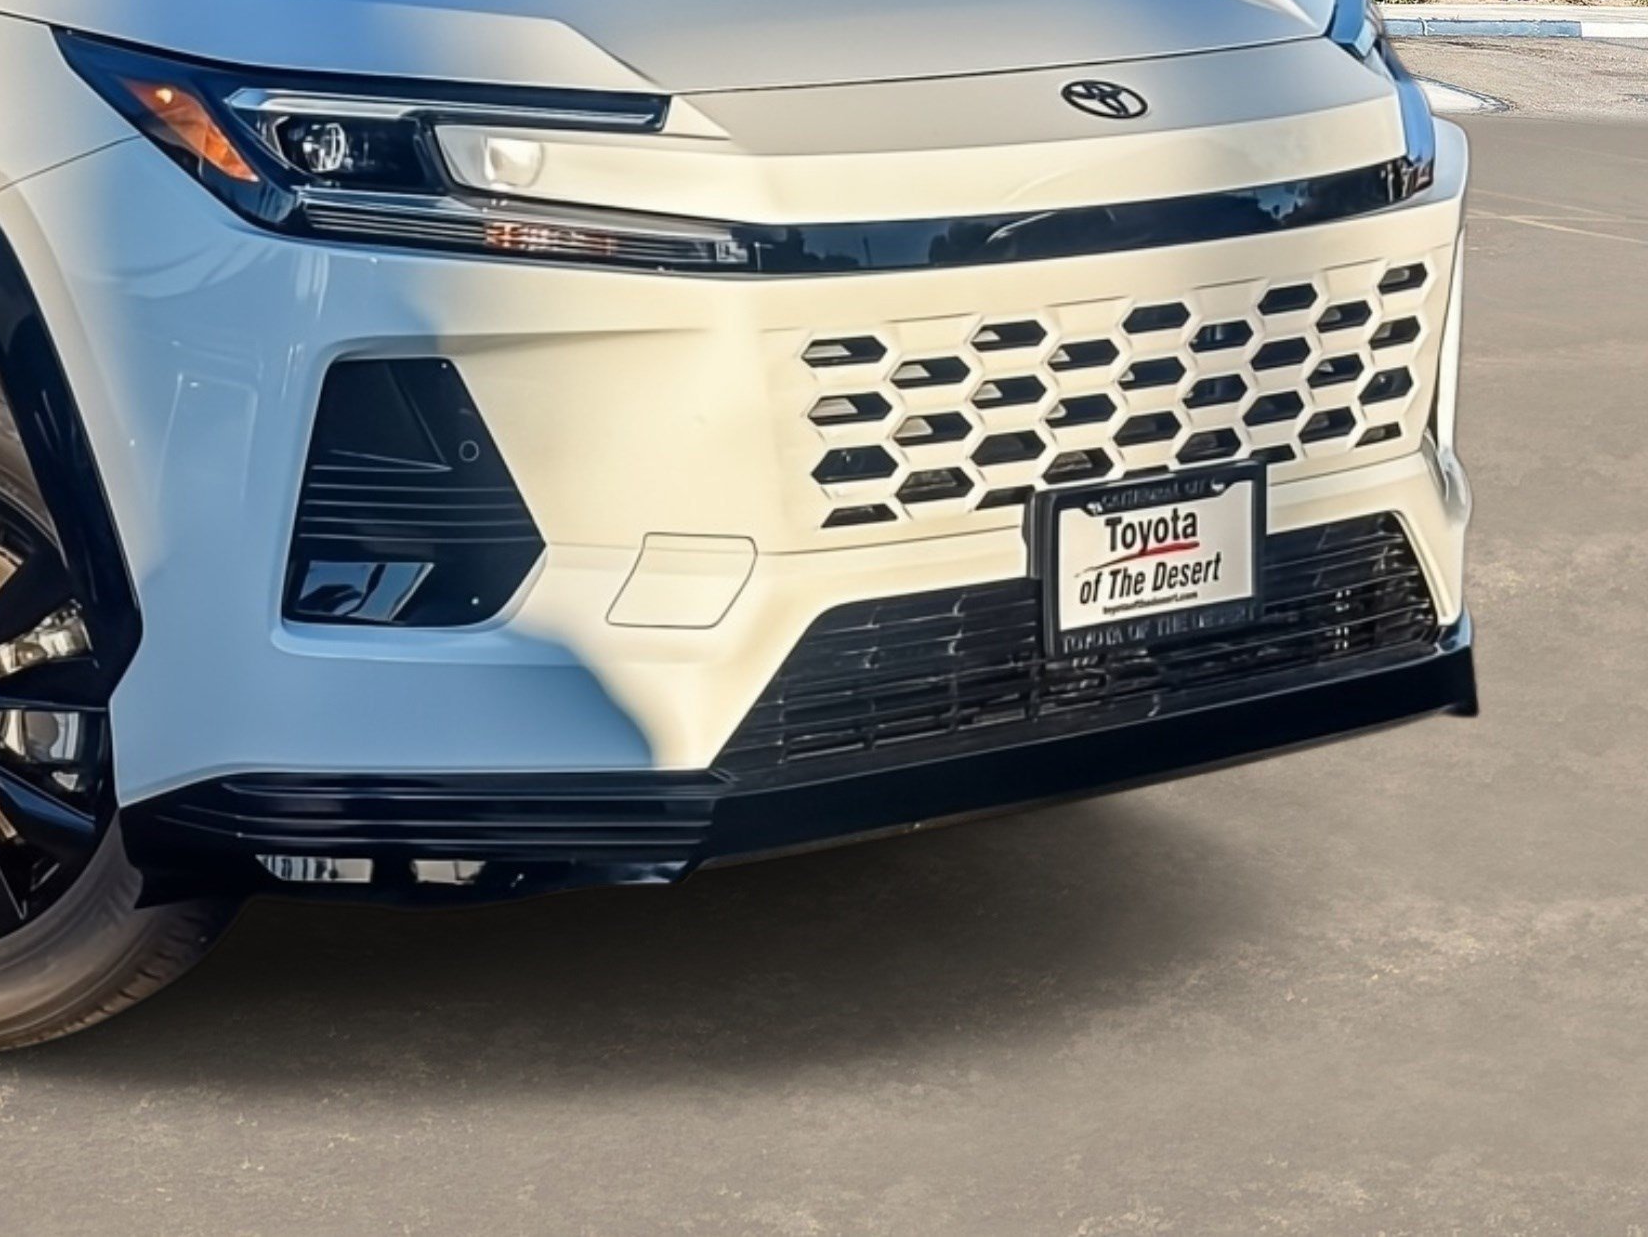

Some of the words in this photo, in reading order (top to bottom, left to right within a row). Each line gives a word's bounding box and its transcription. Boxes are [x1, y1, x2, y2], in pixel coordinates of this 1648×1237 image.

[1104, 508, 1198, 554] Toyota
[1080, 571, 1102, 604] of
[1109, 567, 1145, 600] The
[1152, 551, 1221, 591] Desert
